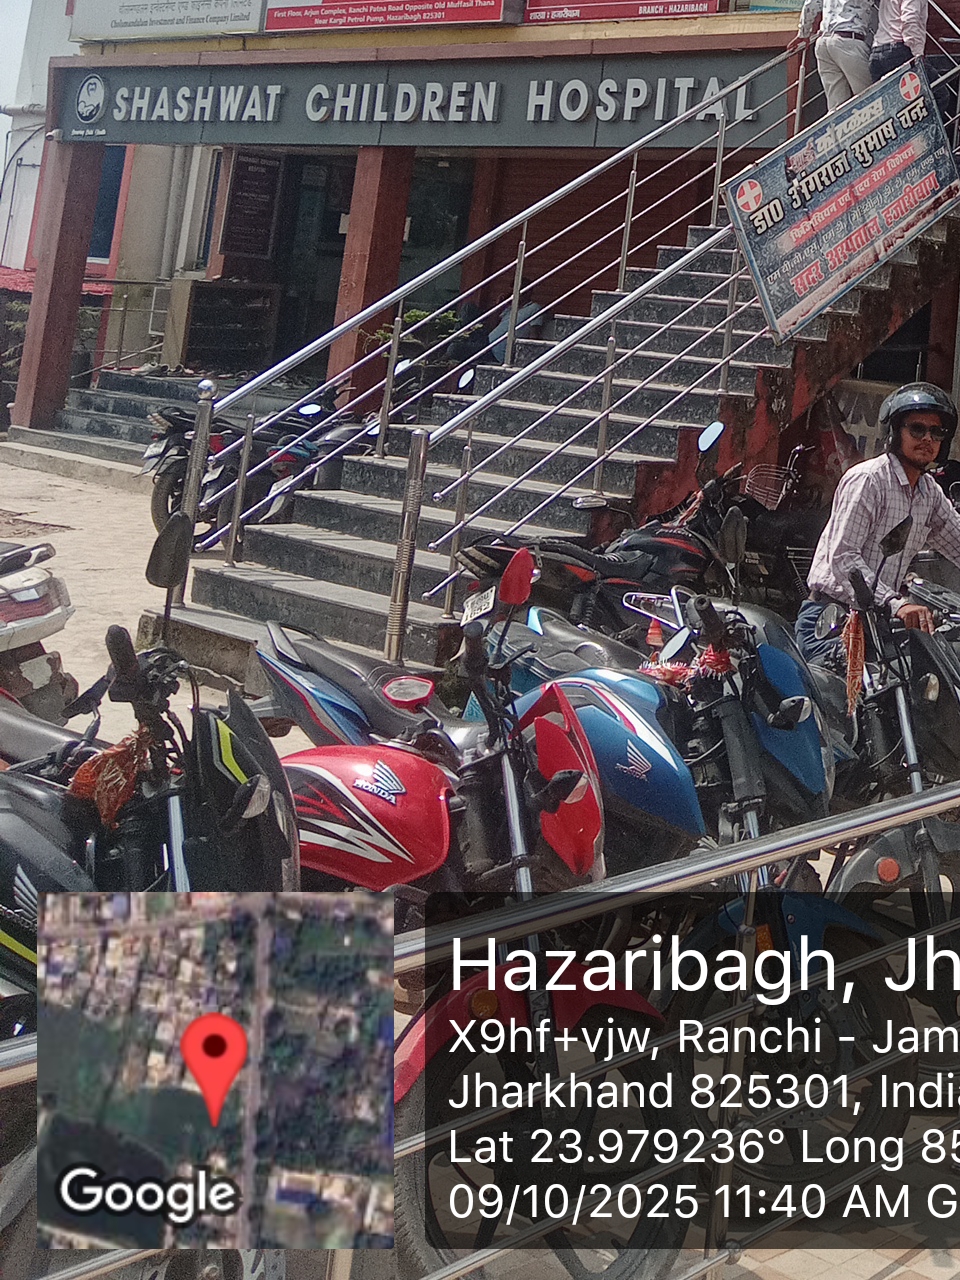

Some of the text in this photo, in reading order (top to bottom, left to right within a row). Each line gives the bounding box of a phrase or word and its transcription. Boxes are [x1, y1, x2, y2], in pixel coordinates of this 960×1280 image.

[186, 15, 205, 25] Finance
[206, 13, 229, 25] Company
[229, 12, 251, 23] Limited
[274, 10, 286, 18] First
[304, 9, 319, 18] Arjun
[348, 5, 368, 14] Ranchi
[369, 5, 386, 13] Patna
[405, 3, 433, 12] Opposite
[434, 1, 446, 9] Old
[475, 0, 495, 7] Thana
[314, 17, 328, 25] Near
[329, 16, 346, 25] Kargil
[387, 12, 421, 21] Hazaribagh
[422, 12, 445, 20] 825301
[639, 3, 708, 15] BRANCH HAZARIBAGH
[113, 76, 758, 122] SHASHWAT CHILDREN HOSPITAL
[788, 151, 852, 209] अंगराज
[850, 117, 897, 169] सुभाष
[896, 96, 929, 132] चन्द्र
[872, 166, 886, 185] रोग
[789, 257, 825, 297] सदर
[825, 216, 882, 272] अस्पताल
[352, 778, 396, 805] HONDA
